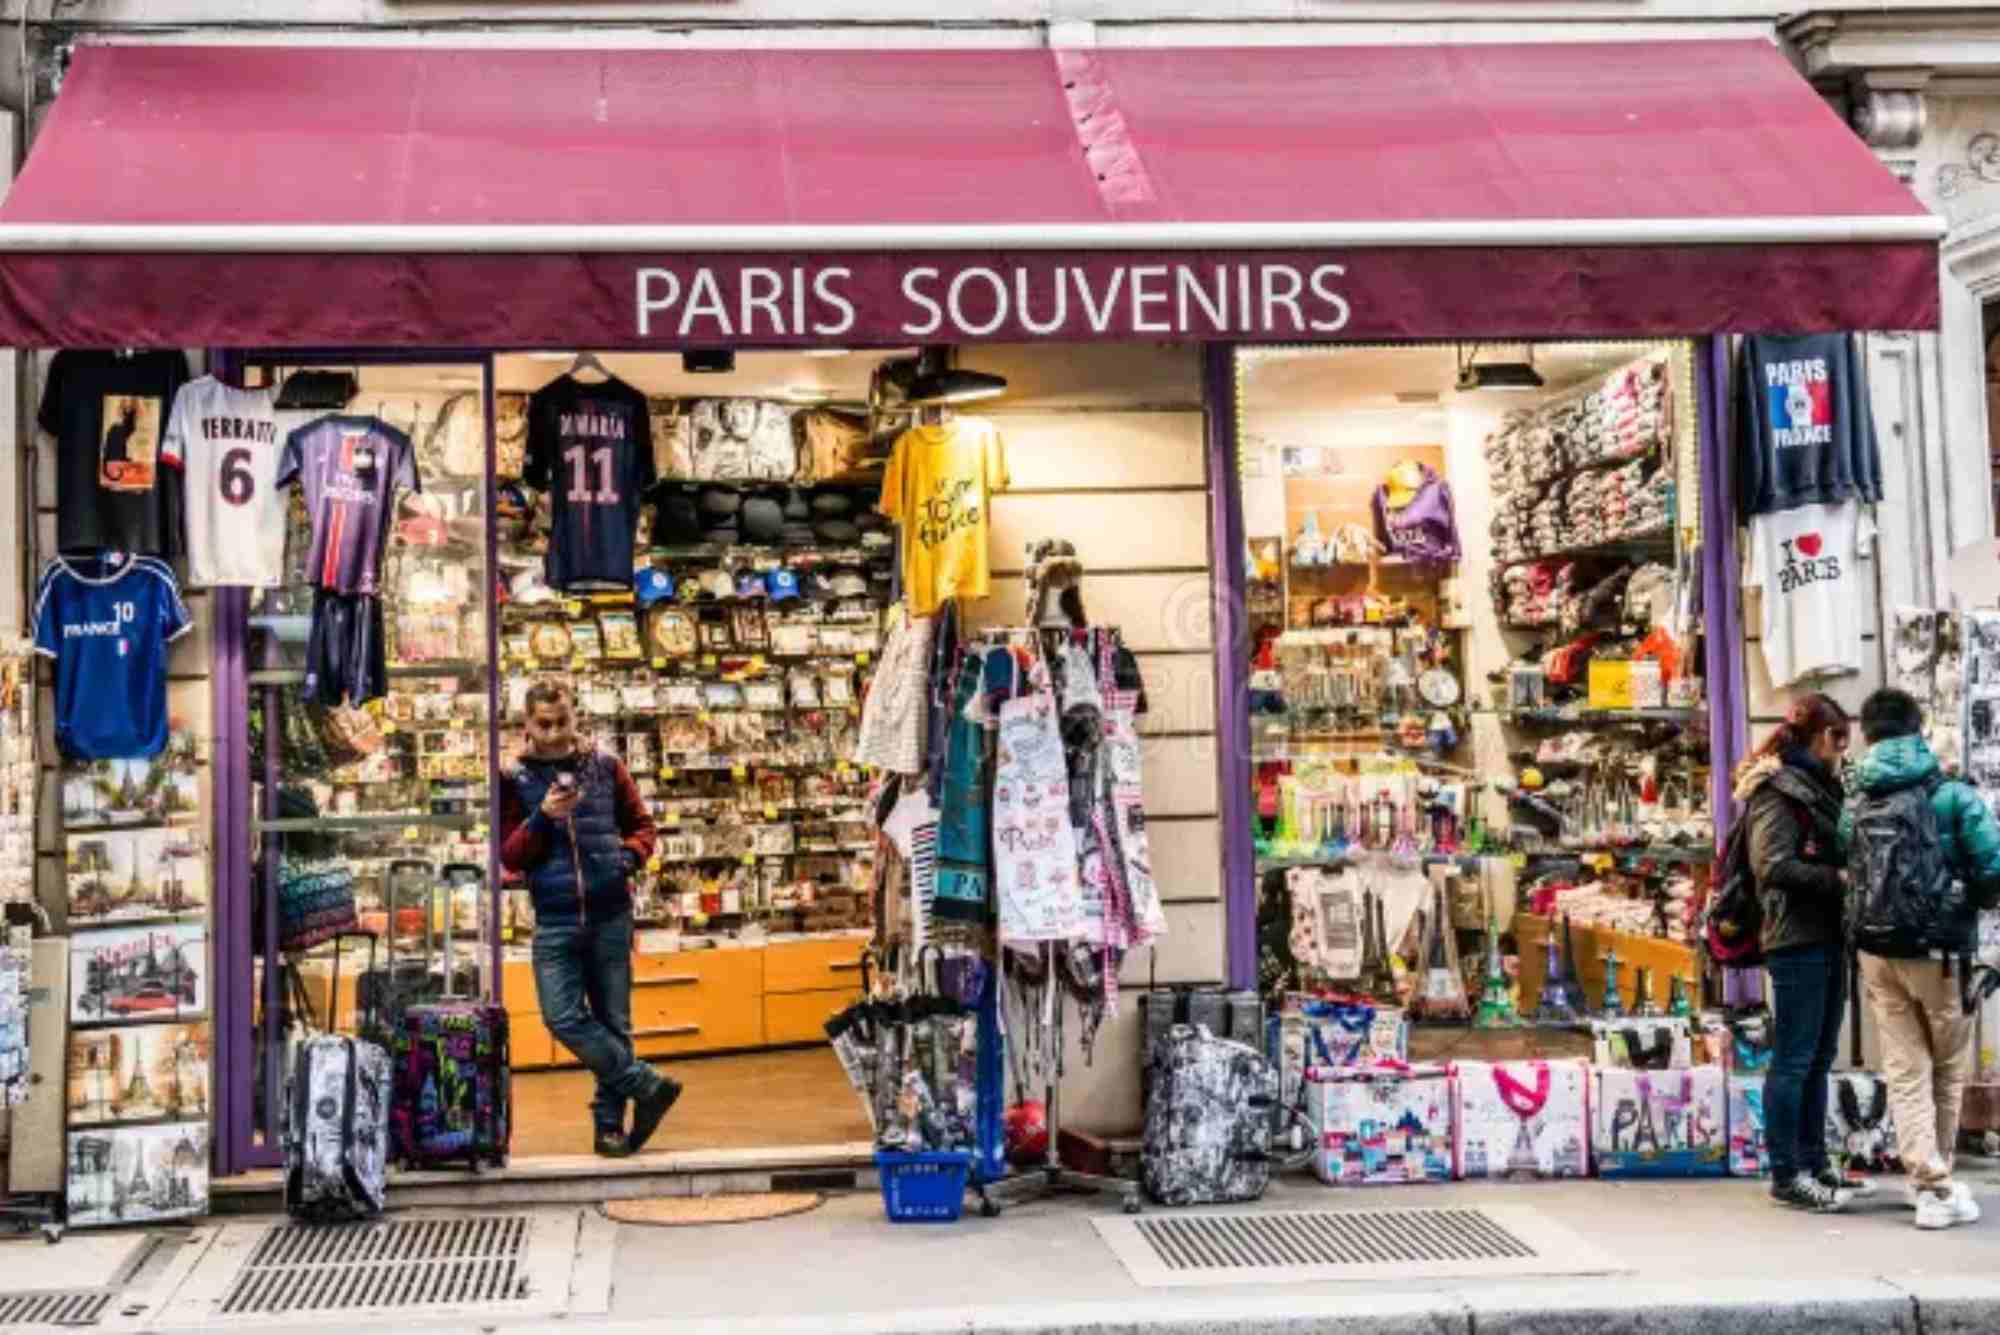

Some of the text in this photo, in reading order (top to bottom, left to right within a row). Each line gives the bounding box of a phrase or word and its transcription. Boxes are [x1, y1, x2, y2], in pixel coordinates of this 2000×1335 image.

[636, 264, 1350, 337] PARIS SOUVENIRS
[1765, 359, 1826, 387] PARIS
[1773, 424, 1832, 448] FRANCE
[220, 447, 255, 507] 6
[563, 445, 619, 504] 11
[1780, 539, 1796, 565] I
[1778, 555, 1842, 593] PARIS
[112, 601, 135, 624] 10
